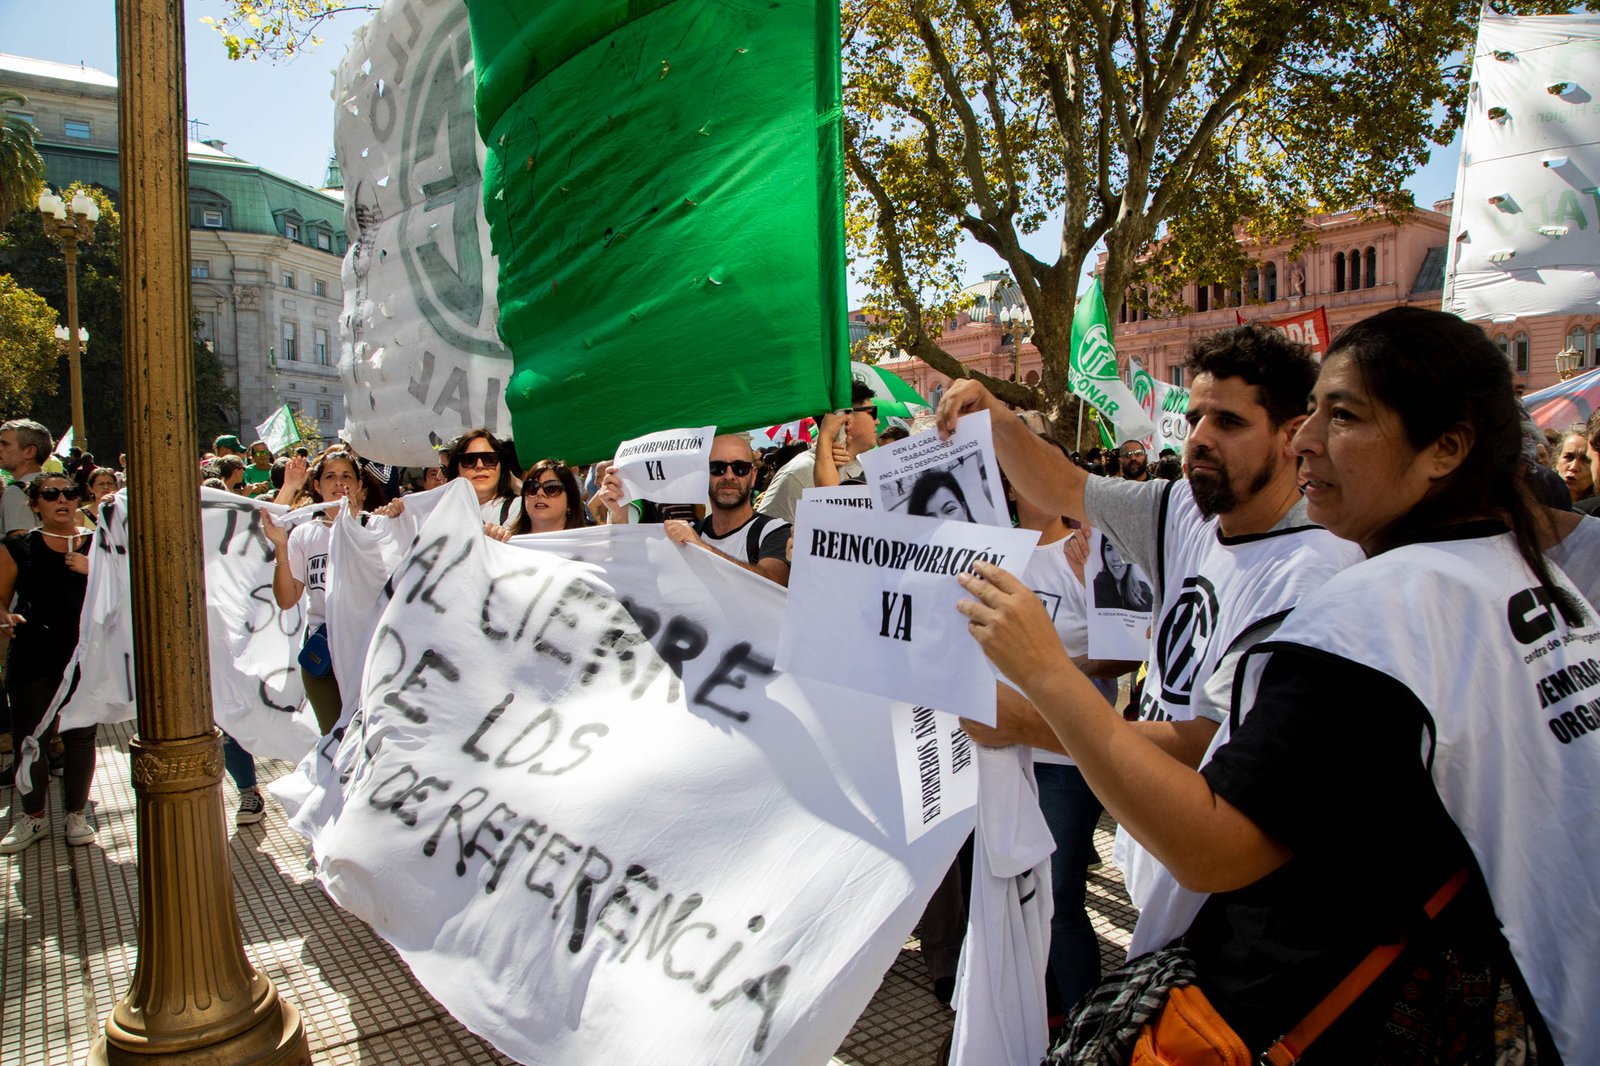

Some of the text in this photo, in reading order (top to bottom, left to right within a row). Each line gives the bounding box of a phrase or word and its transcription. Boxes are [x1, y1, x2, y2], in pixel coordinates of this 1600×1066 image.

[620, 436, 704, 458] REINCORPORACIÓN
[645, 461, 666, 480] YA
[892, 436, 937, 456] DEN LA CARA
[900, 440, 954, 463] TRABAJADORES
[900, 464, 913, 474] LOS
[915, 452, 949, 469] DESPIDOS
[950, 440, 979, 456] MASIVOS
[810, 528, 1005, 580] REINCORPORACIÓN
[879, 590, 913, 642] YA
[480, 569, 783, 723] CIERRE
[1548, 638, 1561, 651] de
[367, 624, 461, 725] DE
[462, 692, 610, 776] LOS
[910, 705, 941, 825] EN PRIMEROS AÑOS
[368, 765, 453, 826] DE
